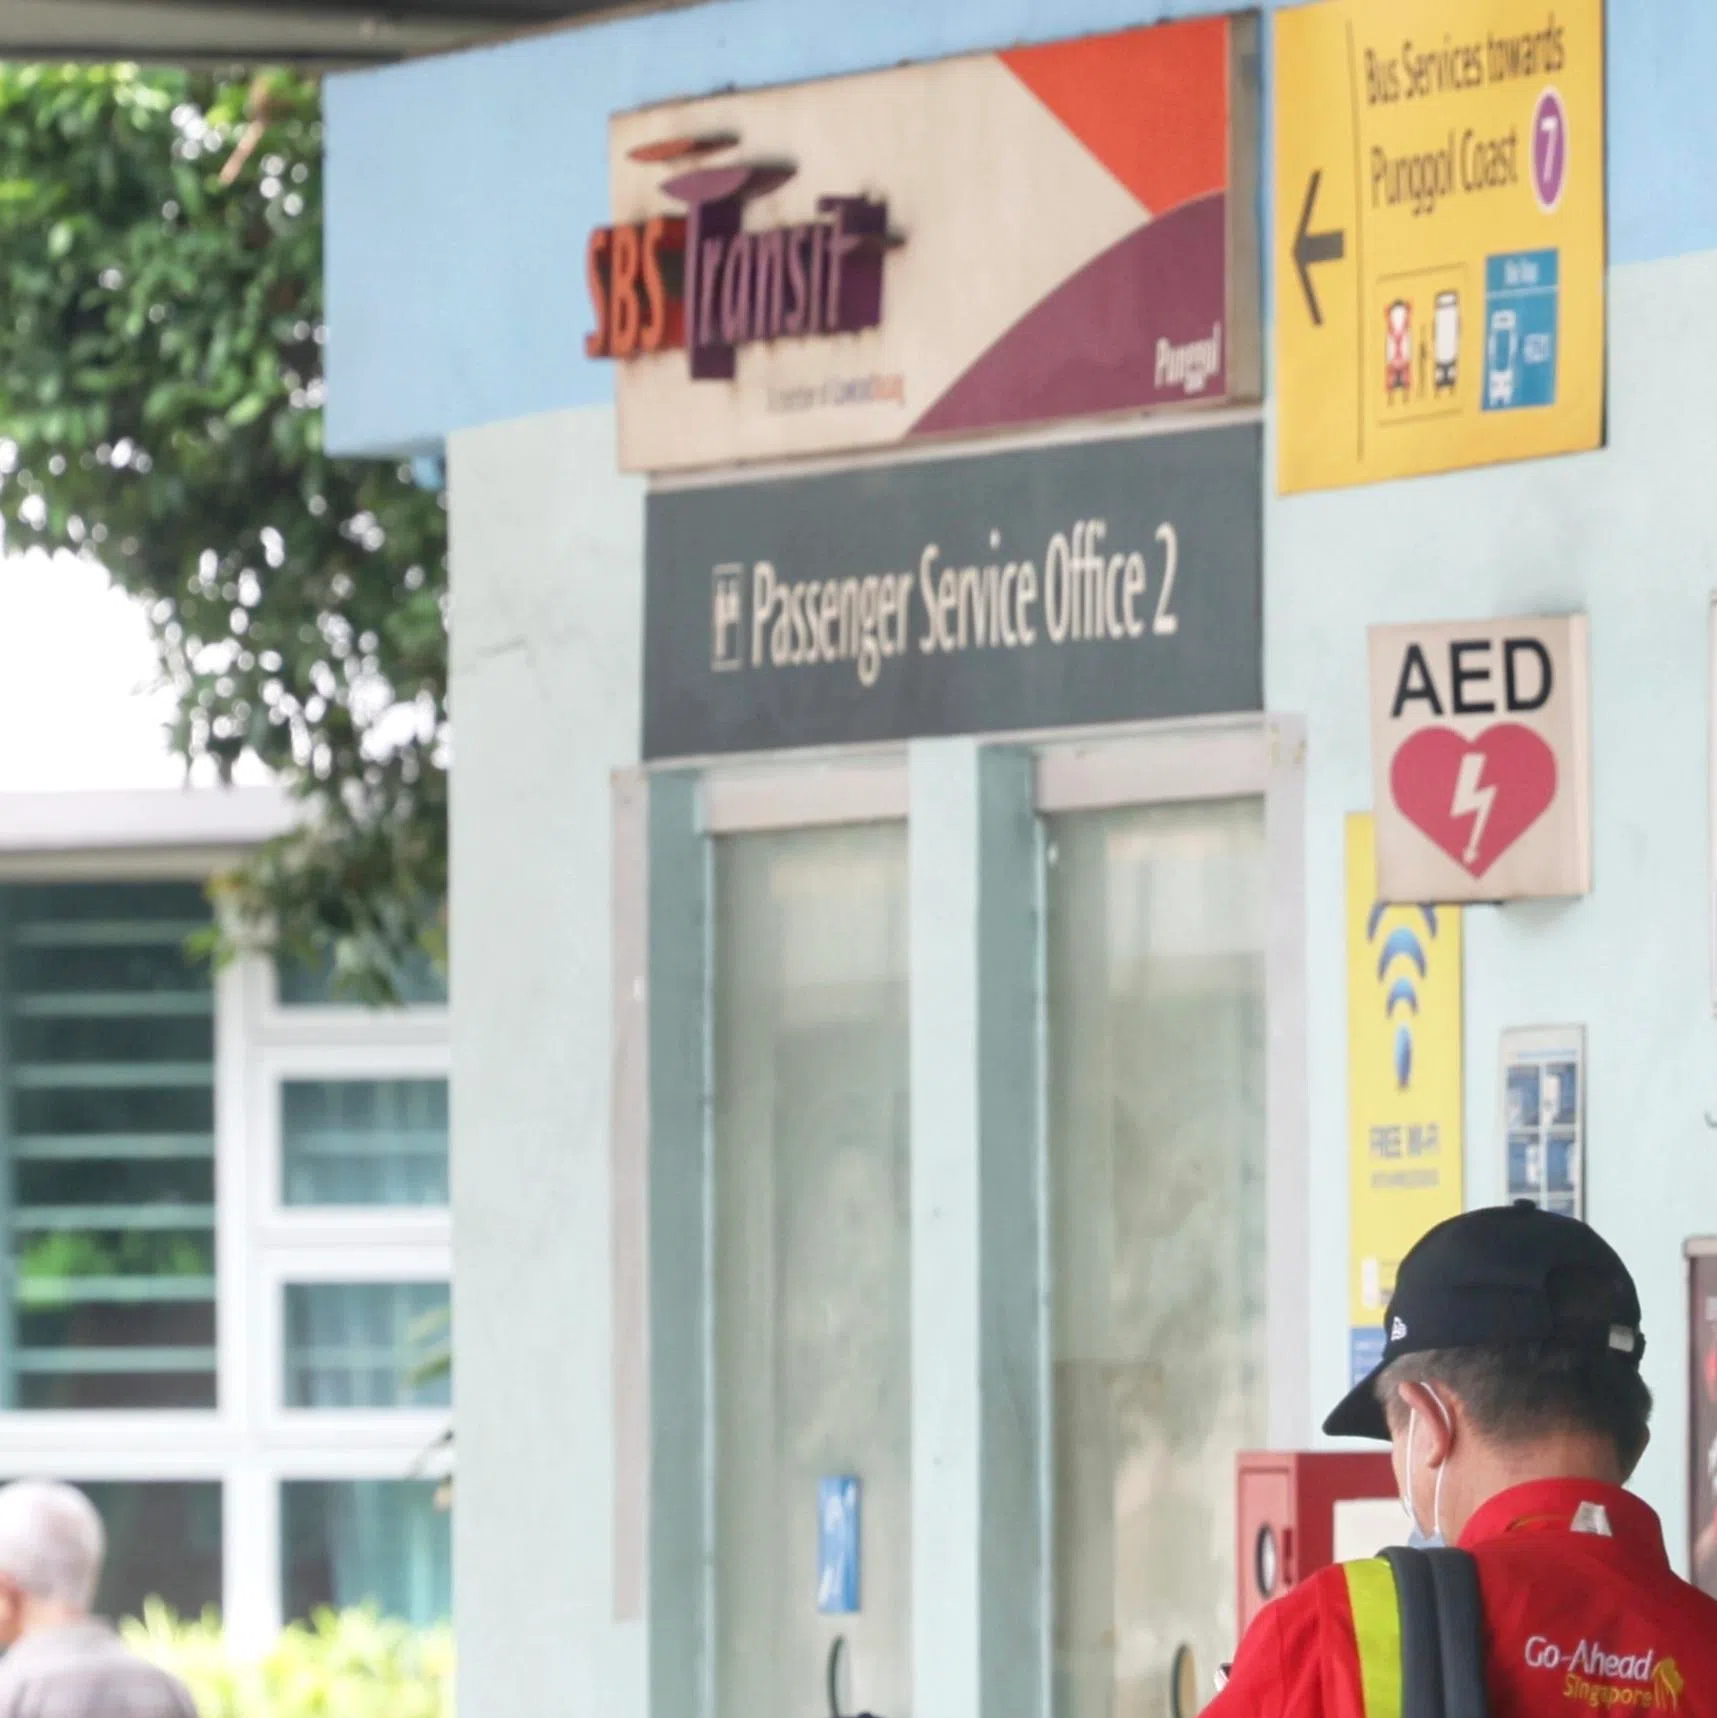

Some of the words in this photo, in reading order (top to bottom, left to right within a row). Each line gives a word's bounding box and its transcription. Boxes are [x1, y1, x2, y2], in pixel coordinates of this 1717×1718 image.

[1364, 47, 1399, 104] Bus
[1402, 33, 1483, 97] Services
[1487, 11, 1565, 82] towards
[1371, 131, 1456, 216] Punggol
[1460, 124, 1520, 191] Coast
[585, 214, 665, 359] SBS
[660, 165, 862, 348] Transit
[751, 560, 914, 687] Passenger
[919, 528, 1037, 655] Service
[1044, 518, 1146, 645] Office
[1153, 521, 1179, 635] 2
[1390, 636, 1555, 719] AED
[1524, 1634, 1654, 1682] Go-Ahead
[1562, 1672, 1652, 1709] Singapore
